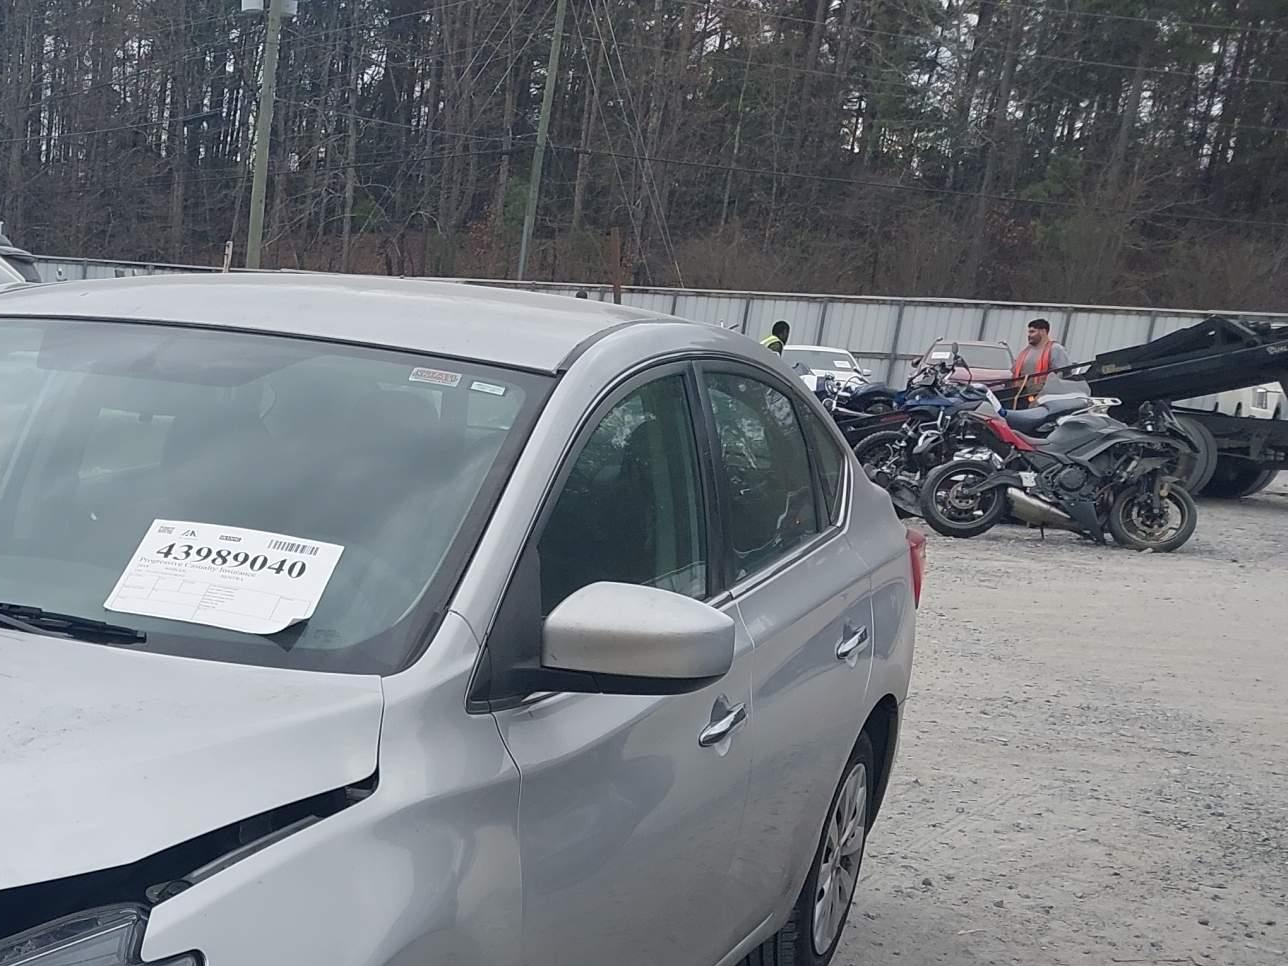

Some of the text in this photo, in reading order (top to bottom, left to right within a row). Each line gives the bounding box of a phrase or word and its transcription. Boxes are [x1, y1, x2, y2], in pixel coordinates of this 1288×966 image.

[139, 557, 183, 568] Progressive
[184, 560, 217, 573] Casualty
[219, 566, 257, 577] Insurance
[156, 542, 306, 578] 43989040
